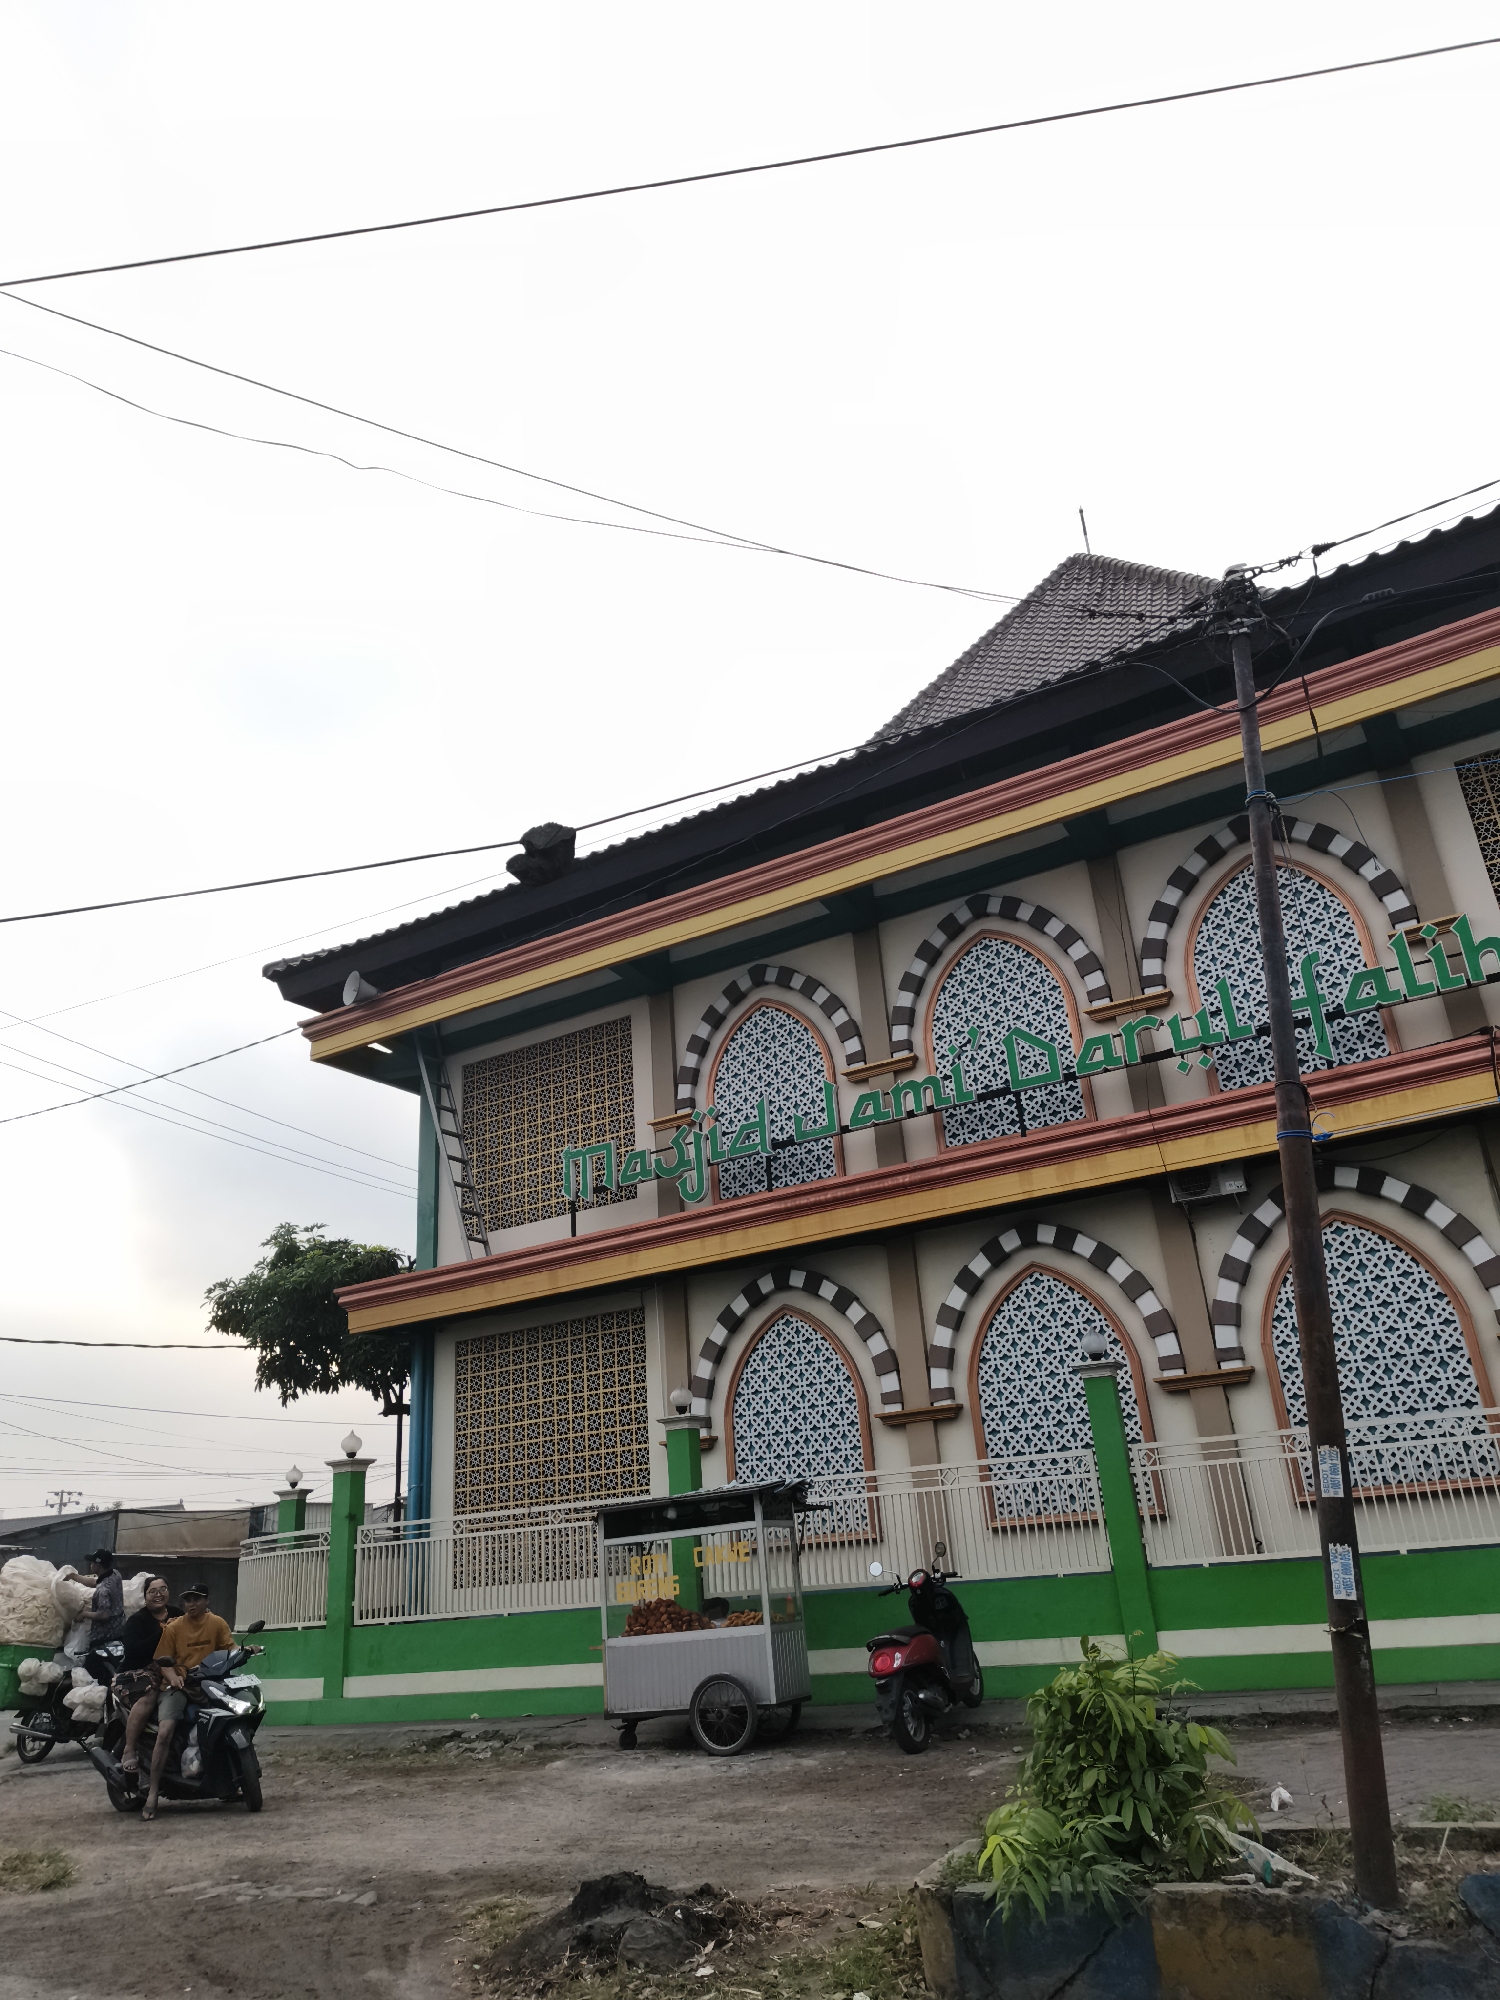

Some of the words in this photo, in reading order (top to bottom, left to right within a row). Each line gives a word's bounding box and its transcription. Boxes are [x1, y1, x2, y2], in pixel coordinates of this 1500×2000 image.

[1001, 974, 1257, 1091] Darul
[1319, 1450, 1328, 1466] WC
[1322, 1469, 1330, 1494] SEDOT
[630, 1553, 668, 1577] ROTI
[693, 1541, 751, 1567] CAKWE
[1333, 1568, 1342, 1595] SEDOT
